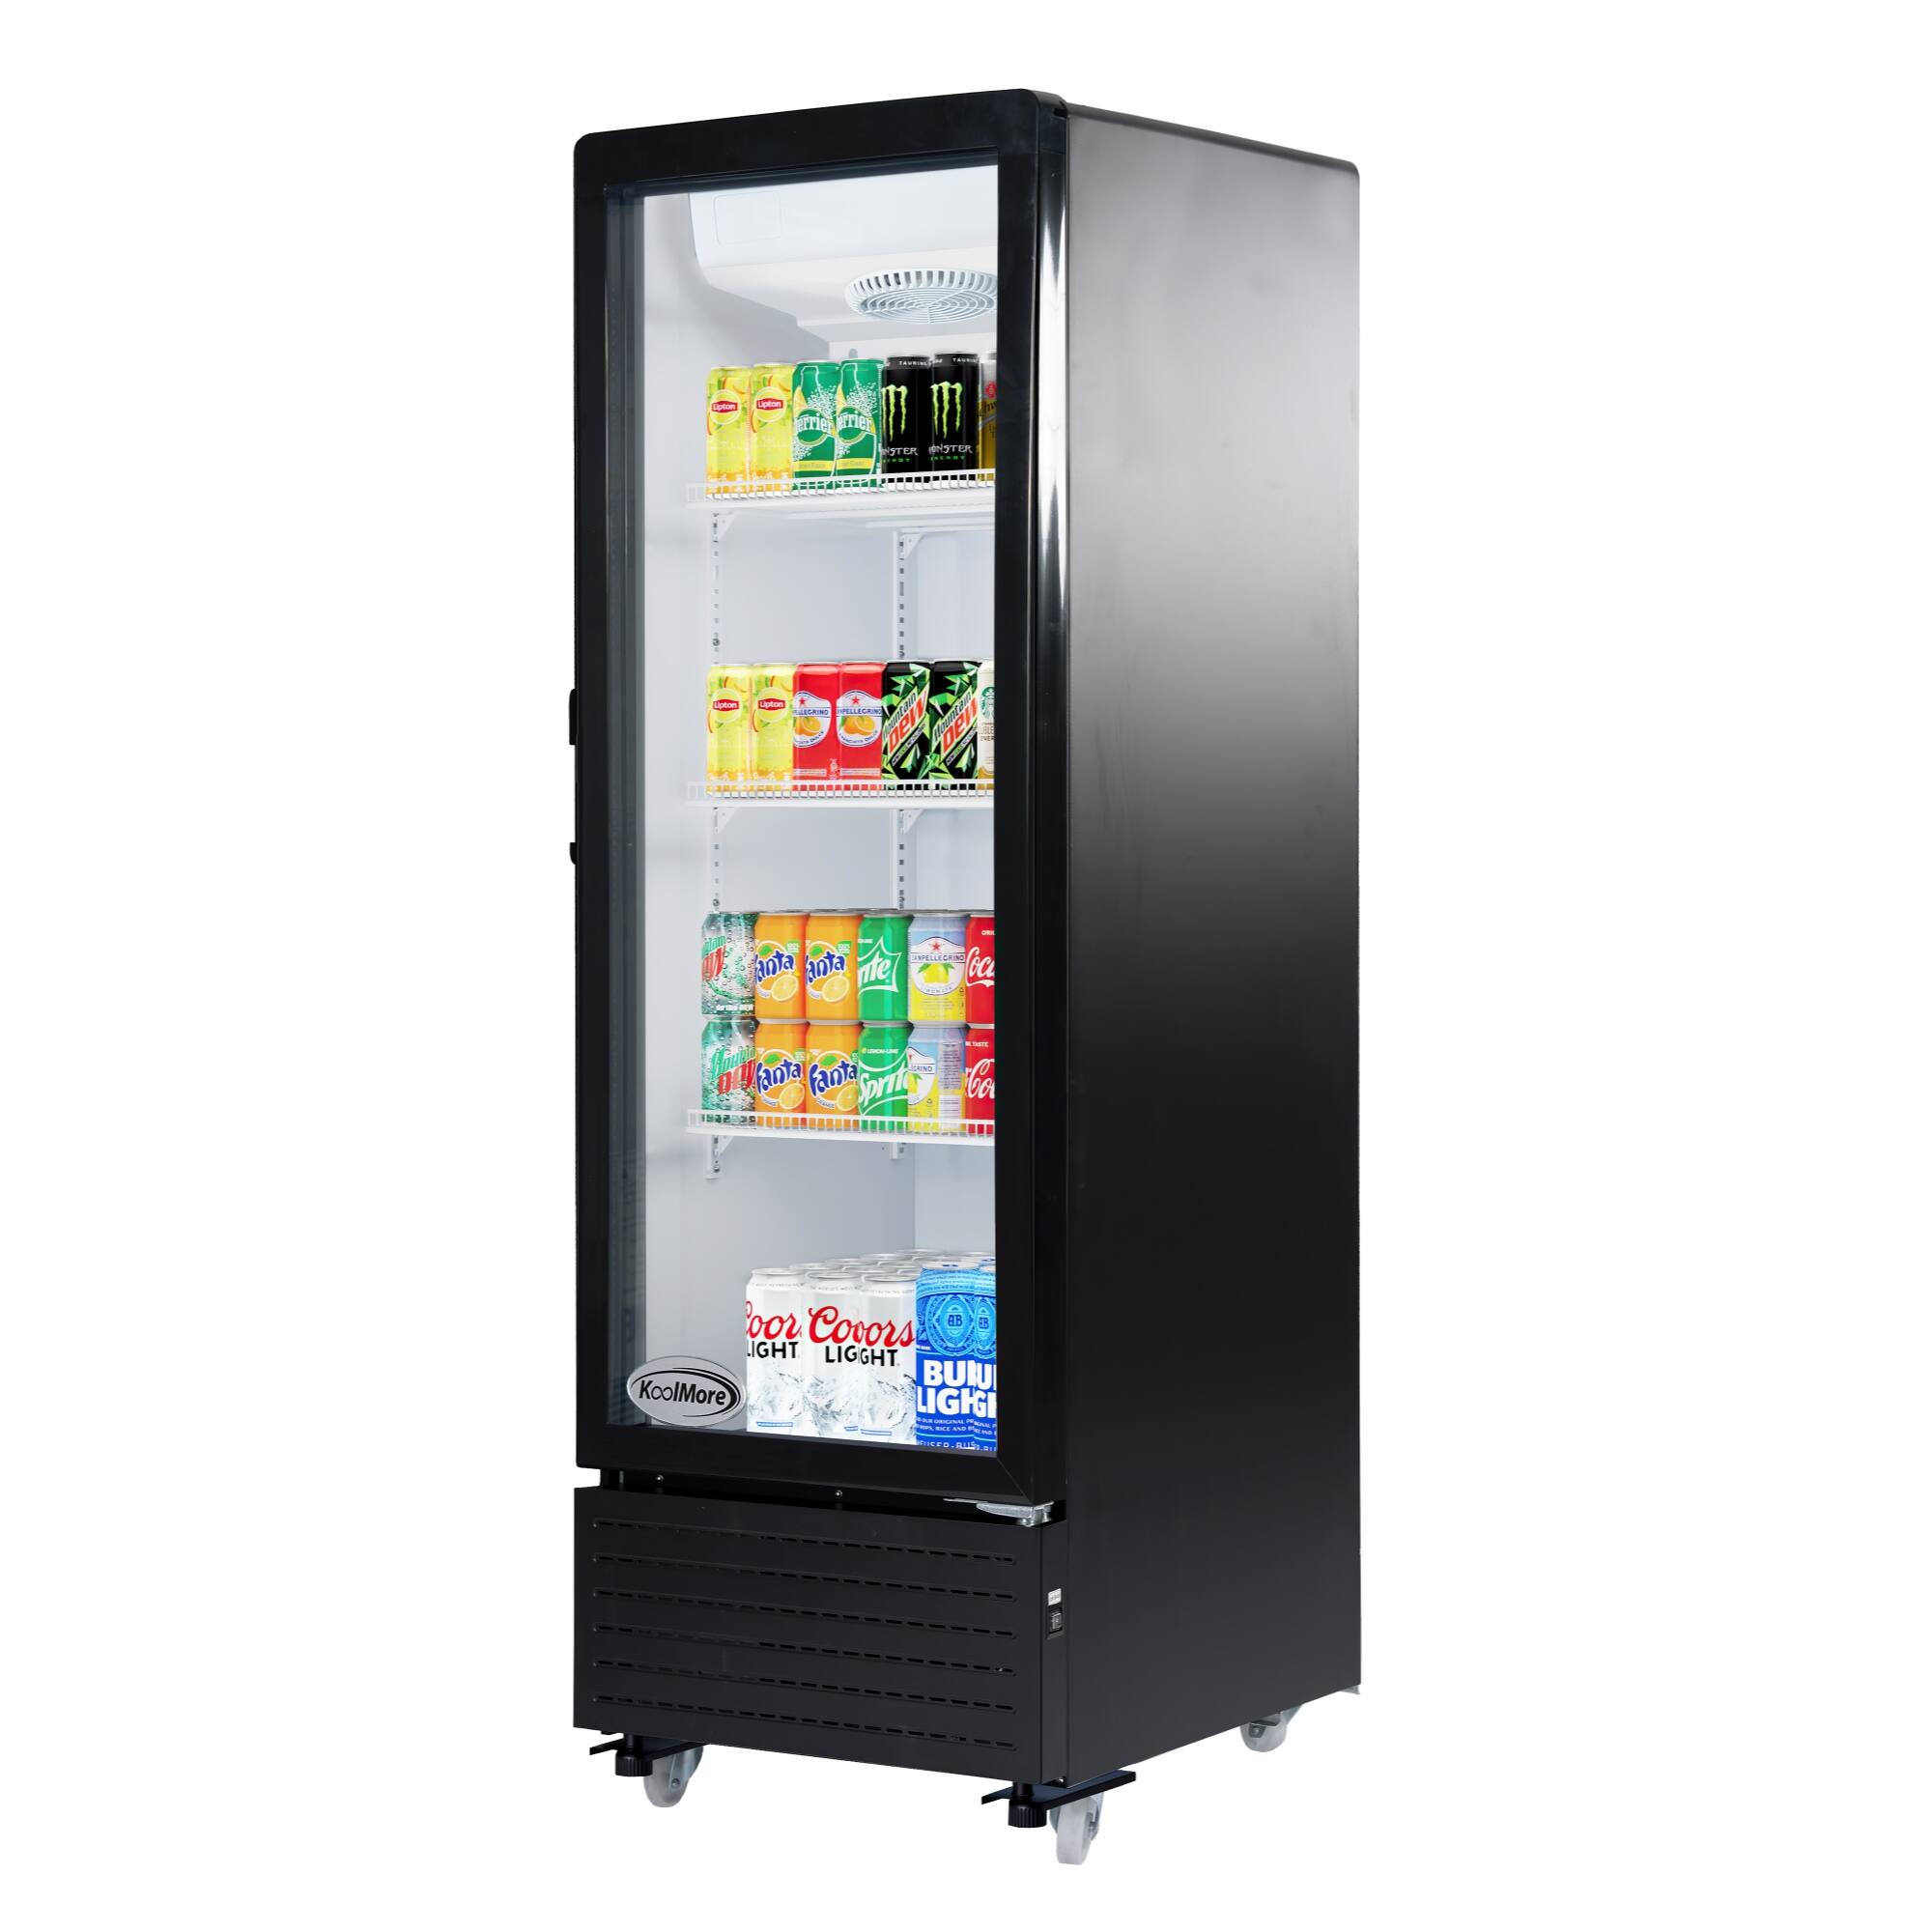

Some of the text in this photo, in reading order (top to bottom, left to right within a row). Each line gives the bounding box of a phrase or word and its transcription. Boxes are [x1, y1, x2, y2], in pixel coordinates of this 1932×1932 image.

[759, 700, 784, 709] Lipton
[747, 1341, 799, 1359] IGHT
[639, 1379, 726, 1406] KoolMore
